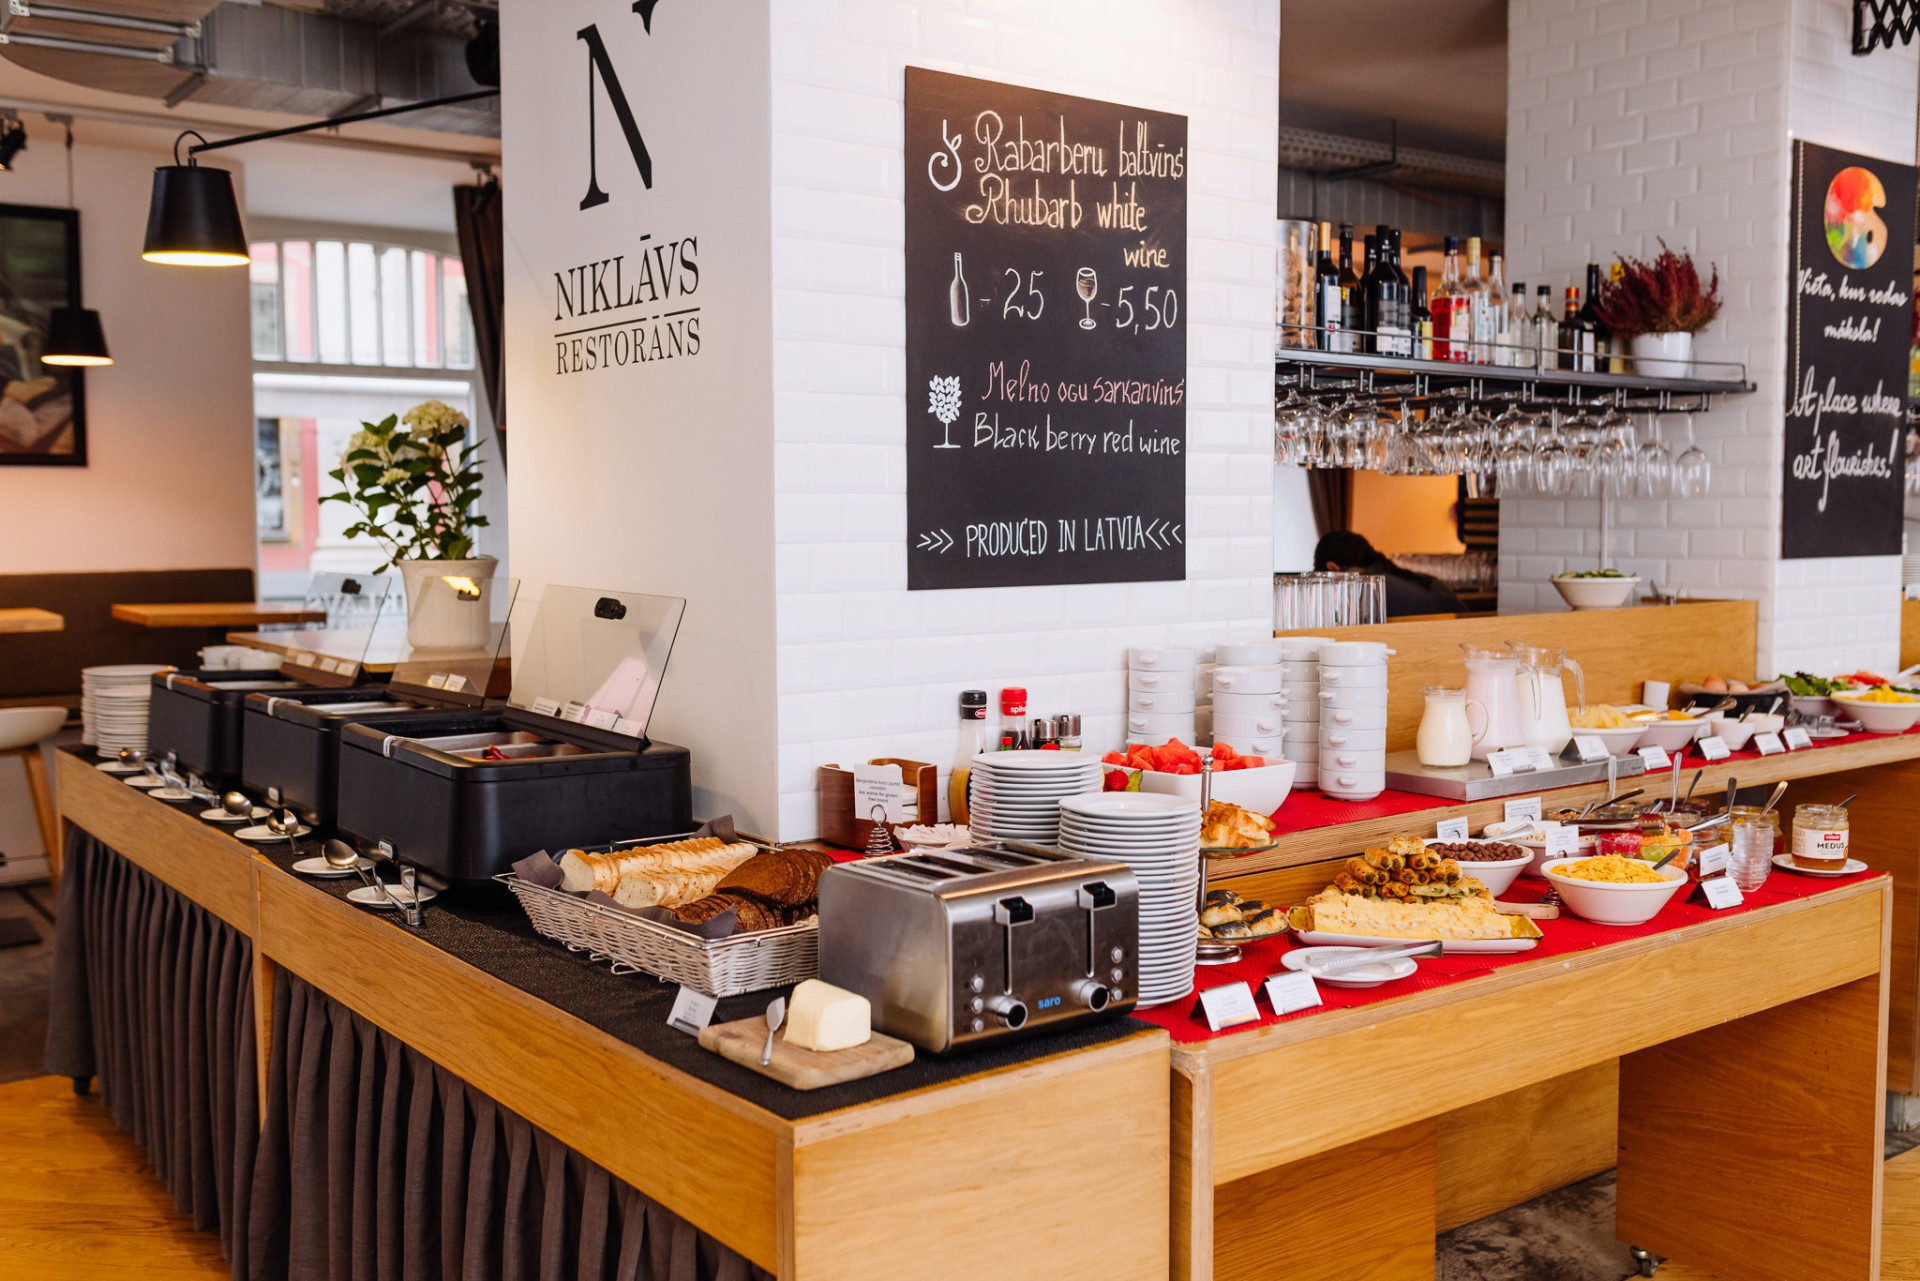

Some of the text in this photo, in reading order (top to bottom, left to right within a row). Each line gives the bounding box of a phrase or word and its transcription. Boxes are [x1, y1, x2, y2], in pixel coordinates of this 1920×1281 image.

[974, 109, 1107, 177] Rabarberu
[965, 172, 1148, 232] Rhubarb white
[554, 233, 700, 321] NIKLĀVS
[1123, 240, 1170, 269] wine
[1002, 267, 1045, 320] 25
[555, 315, 701, 375] RESTORĀNS
[981, 359, 1050, 403] Melno
[1812, 376, 1859, 437] place
[1860, 379, 1903, 418] where
[973, 412, 1181, 455] Black berry red wine
[965, 514, 1146, 558] PRODUCED IN LATVIA
[1817, 842, 1845, 850] MEDUS
[1037, 995, 1062, 1010] saro
